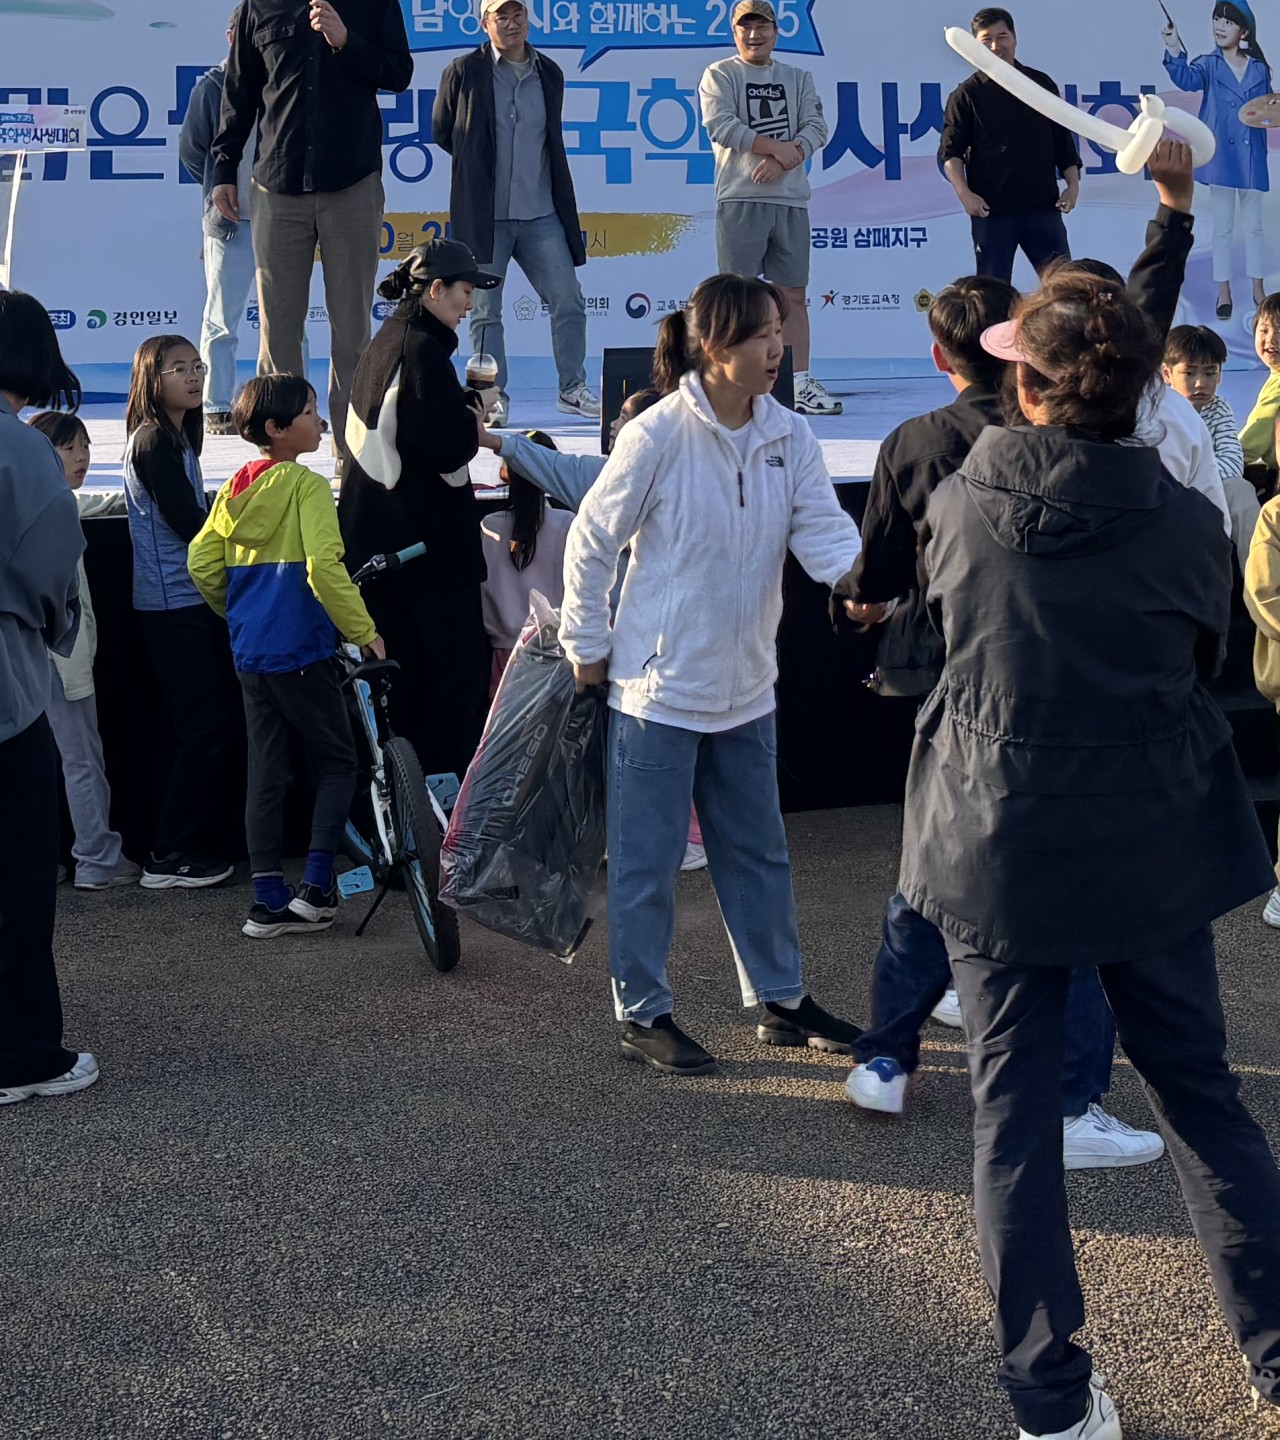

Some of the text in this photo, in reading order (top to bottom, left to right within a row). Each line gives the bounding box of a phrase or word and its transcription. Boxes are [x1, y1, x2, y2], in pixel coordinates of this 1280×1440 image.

[588, 1, 697, 36] 함께하는
[853, 227, 928, 249] 삼패지구
[842, 294, 900, 305] 경기도교육청
[112, 310, 178, 326] 경인일보
